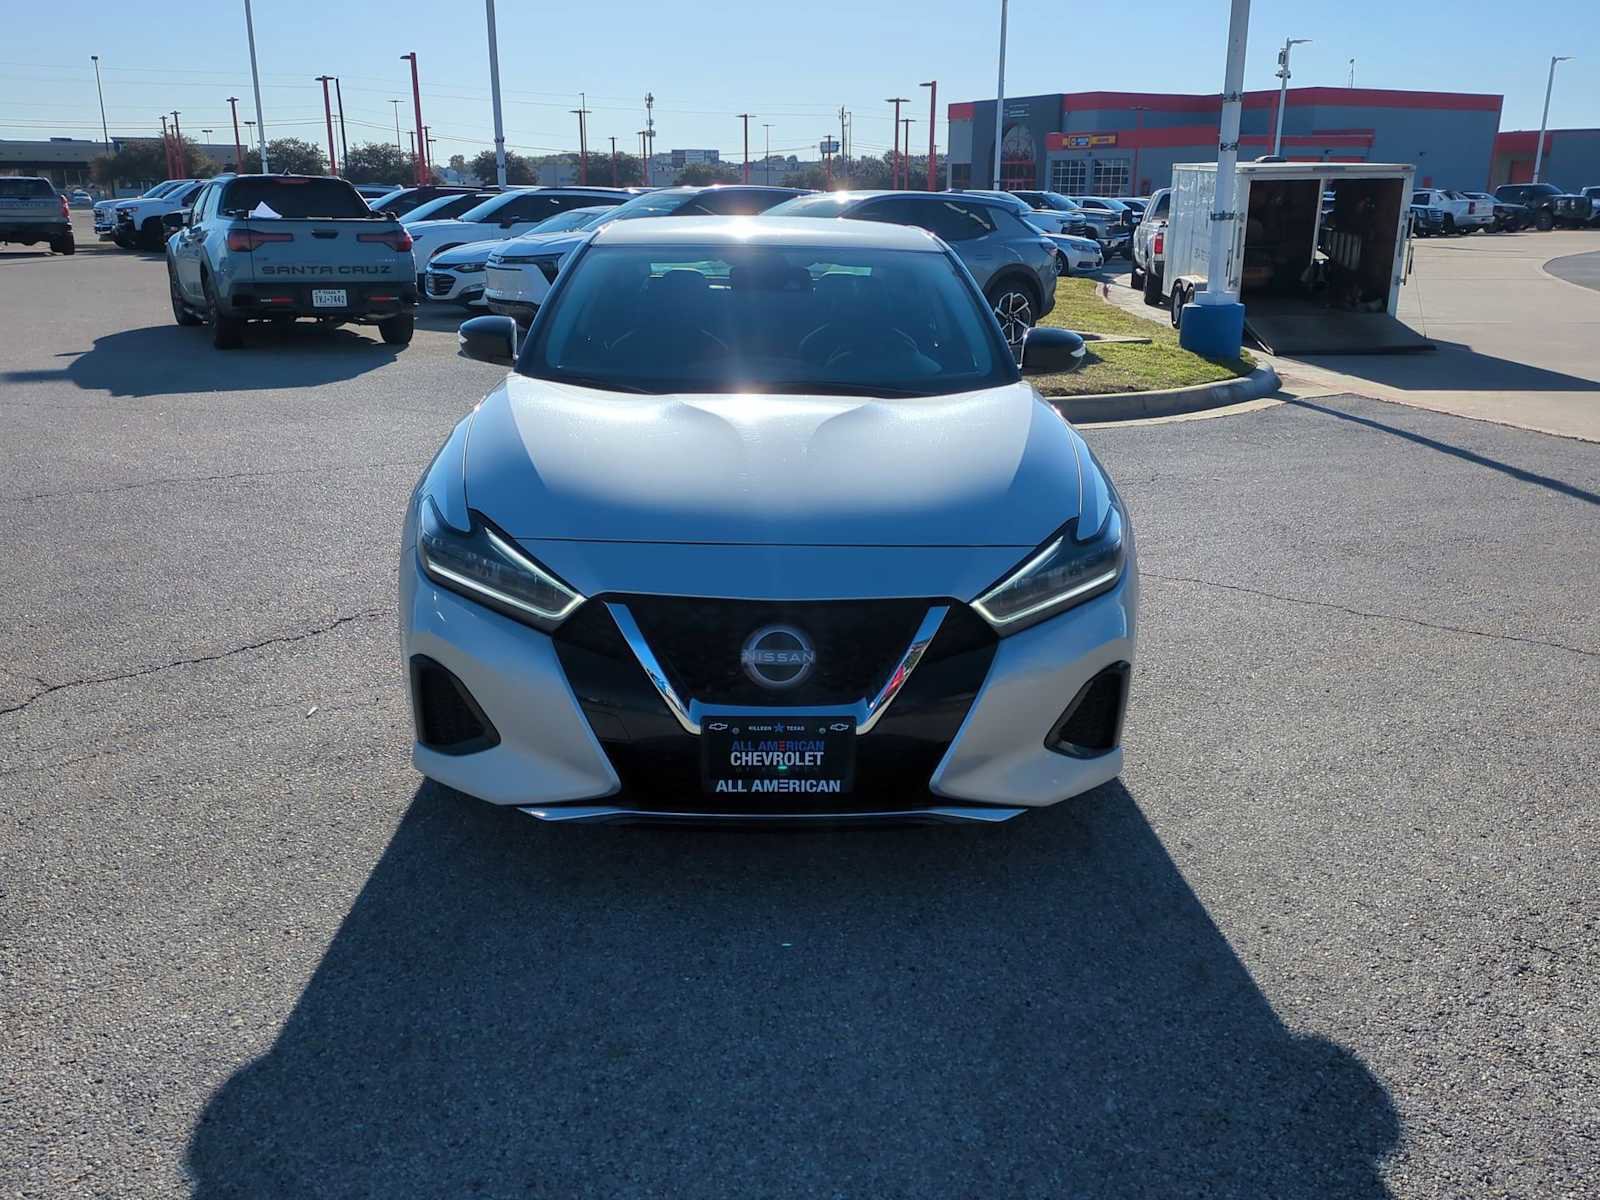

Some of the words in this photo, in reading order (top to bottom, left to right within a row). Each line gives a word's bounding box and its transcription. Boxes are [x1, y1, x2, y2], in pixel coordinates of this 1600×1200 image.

[261, 265, 333, 275] SANTA
[338, 265, 392, 275] CRUZ
[741, 650, 816, 664] NISSAN
[731, 741, 755, 751] ALL
[759, 741, 825, 751] AMERICAN
[730, 752, 824, 766] CHEVROLET
[716, 779, 748, 792] ALL
[751, 779, 840, 792] AMERICAN
